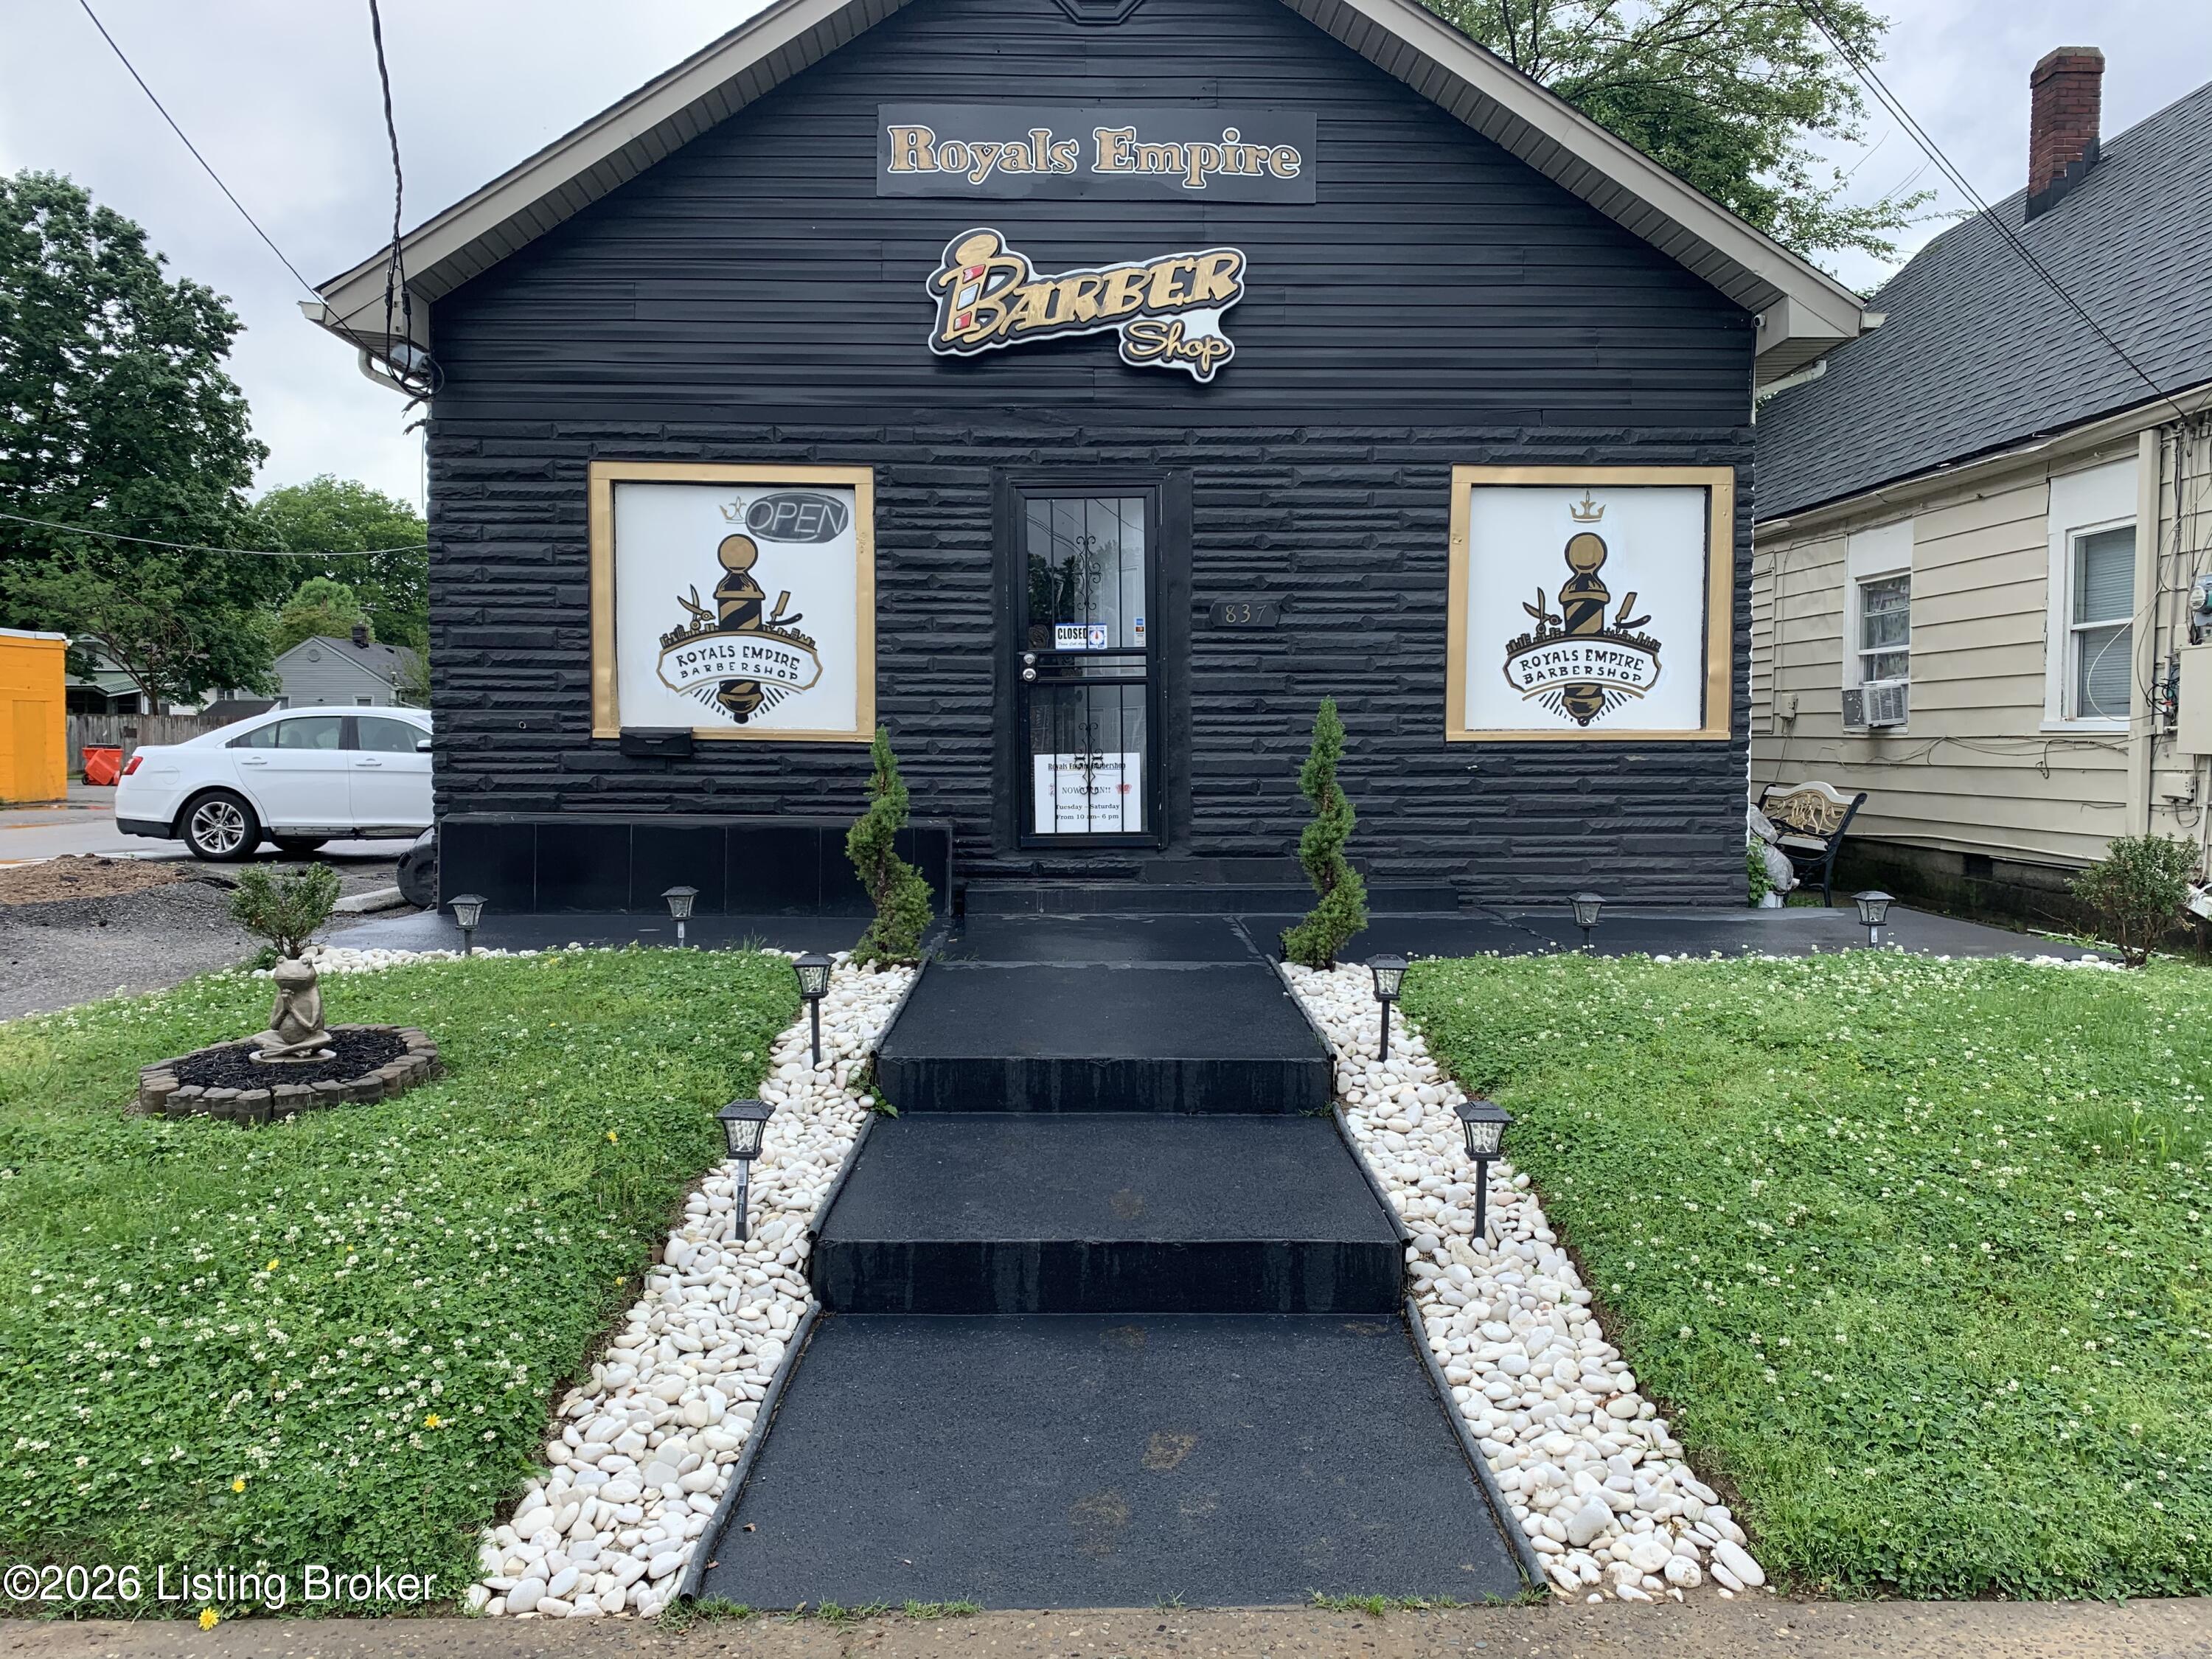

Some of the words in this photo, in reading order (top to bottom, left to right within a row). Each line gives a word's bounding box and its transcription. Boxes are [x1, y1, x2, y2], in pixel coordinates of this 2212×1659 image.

[887, 125, 1079, 184] Royals
[1093, 126, 1301, 189] Empire
[1125, 321, 1230, 372] Shop
[747, 501, 846, 535] OPEN
[1225, 604, 1267, 623] 837
[675, 645, 735, 667] ROYALS
[742, 646, 800, 670] EMPIRE
[1519, 650, 1579, 671] ROYALS
[1585, 649, 1644, 671] EMPIRE
[681, 662, 798, 678] BARBERSHOP
[1523, 666, 1642, 685] BARBERSHOP
